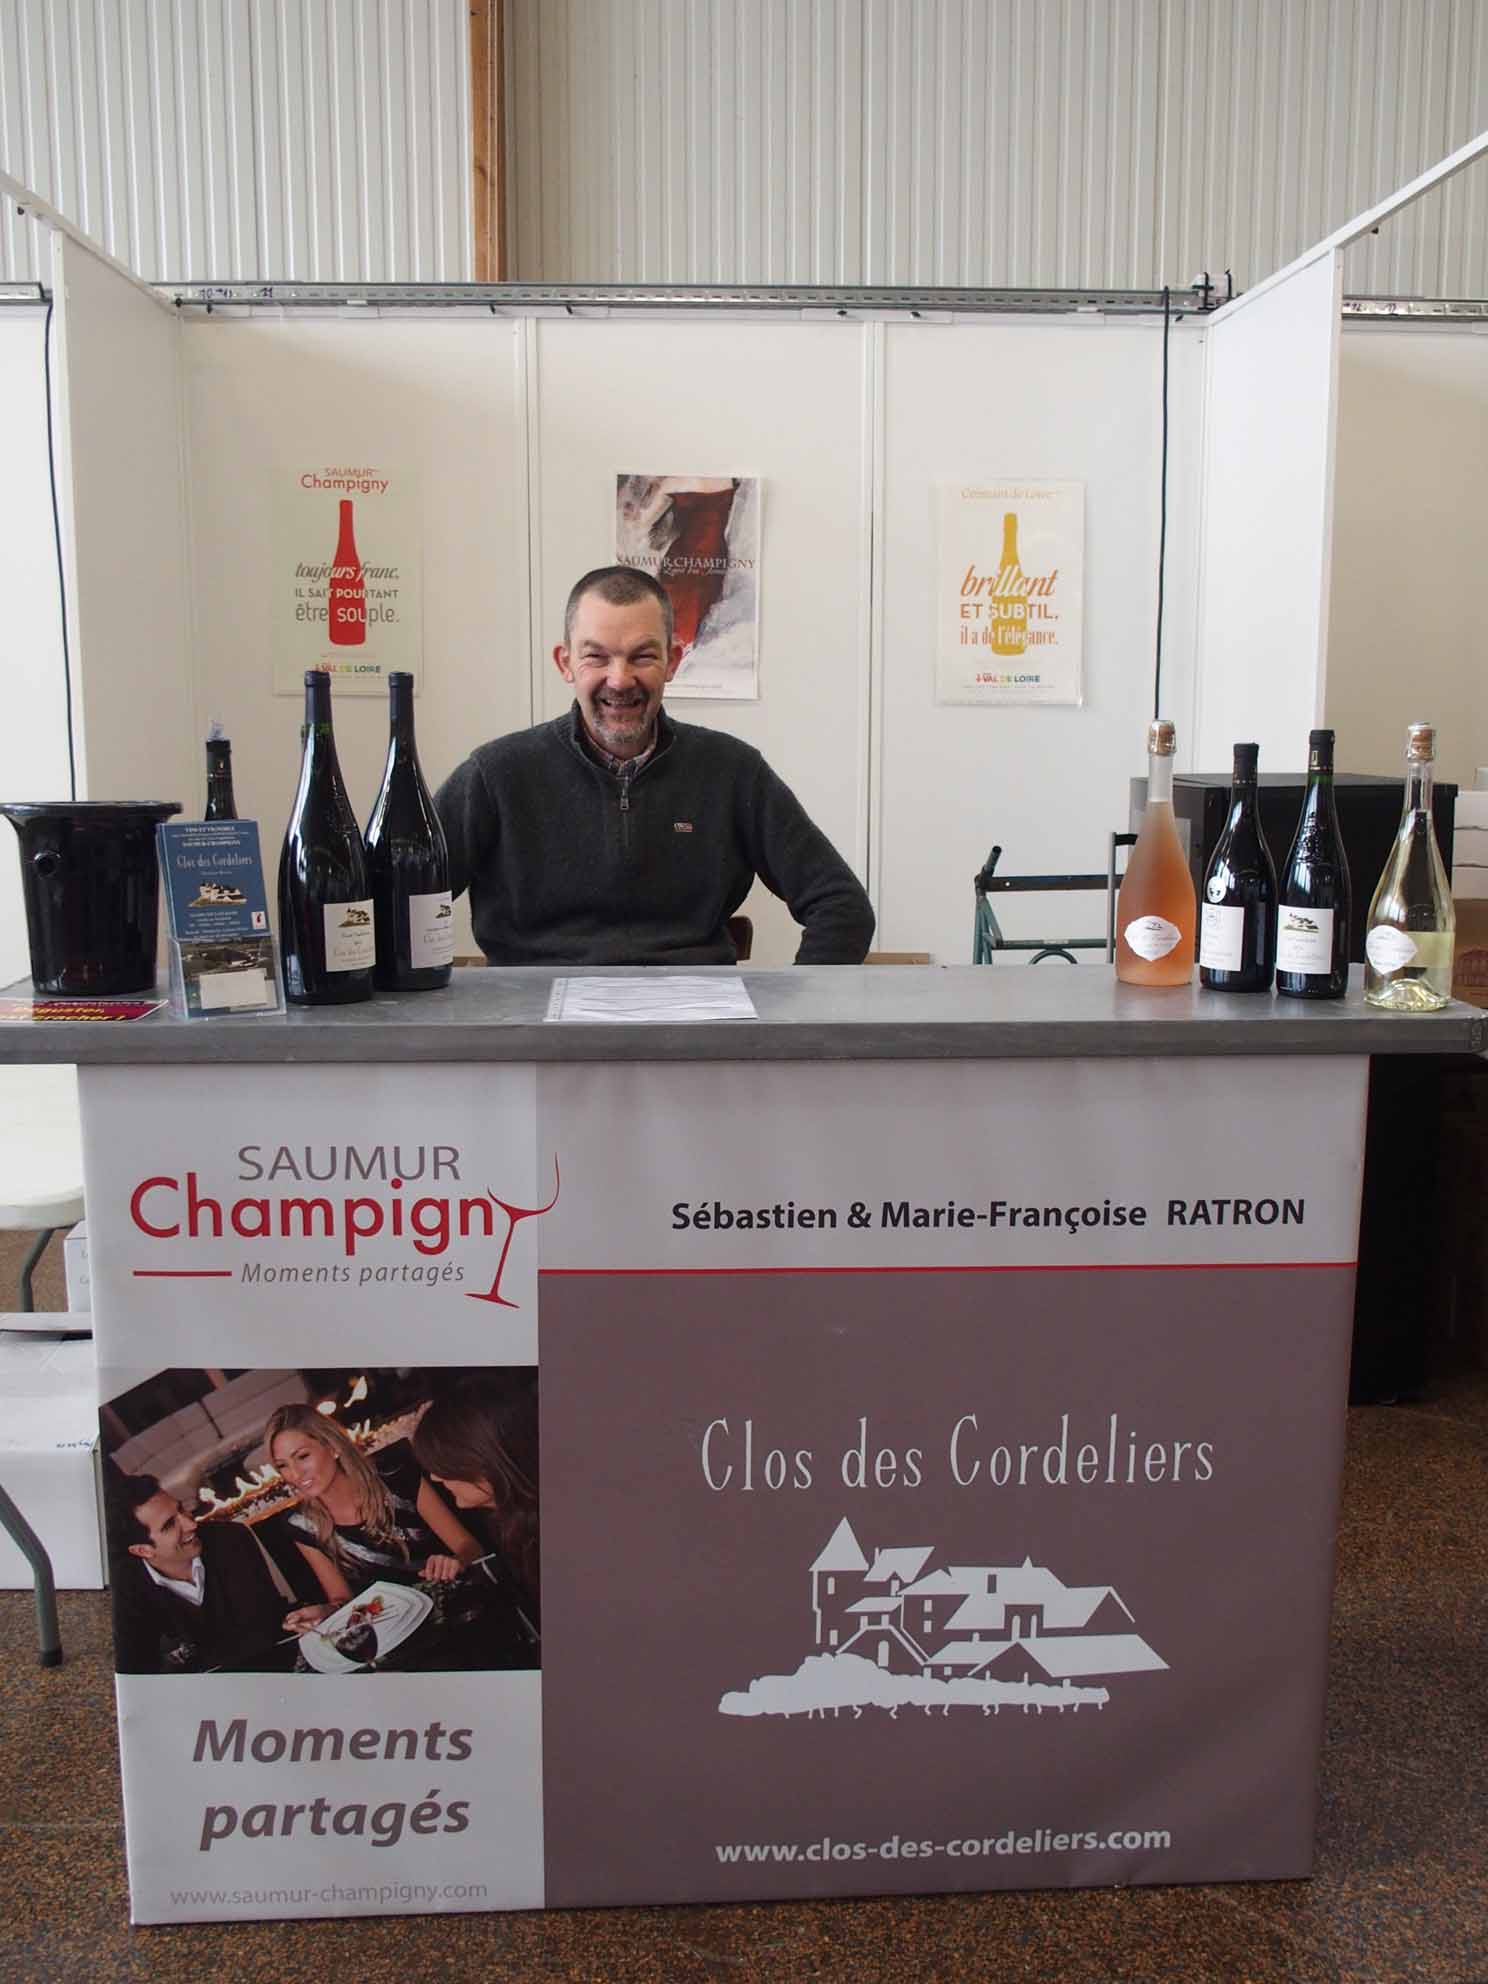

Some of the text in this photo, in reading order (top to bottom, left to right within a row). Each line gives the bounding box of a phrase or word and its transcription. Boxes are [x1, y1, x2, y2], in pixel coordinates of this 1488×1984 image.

[301, 473, 389, 495] Champigny
[295, 561, 400, 583] toujours franc.
[960, 564, 1058, 596] brillant
[295, 588, 399, 599] IL SAIT POURTANT
[295, 601, 328, 622] être
[960, 603, 1059, 620] ET SUBTIL,
[971, 631, 978, 645] a
[354, 665, 382, 673] LOIRE
[1014, 675, 1041, 683] LOIRE
[237, 1145, 461, 1181] SAUMUR
[672, 1199, 1305, 1234] Sébastien & Marie-Françoise RATRON
[241, 1262, 465, 1286] Moments partagés
[701, 1413, 1215, 1491] Clos des Cordeliers
[193, 1719, 473, 1763] Moments
[200, 1789, 470, 1851] partagés
[714, 1828, 1172, 1863] www.clos-des-cordeliers.com
[170, 1881, 488, 1905] www.saumur-champigny.com
